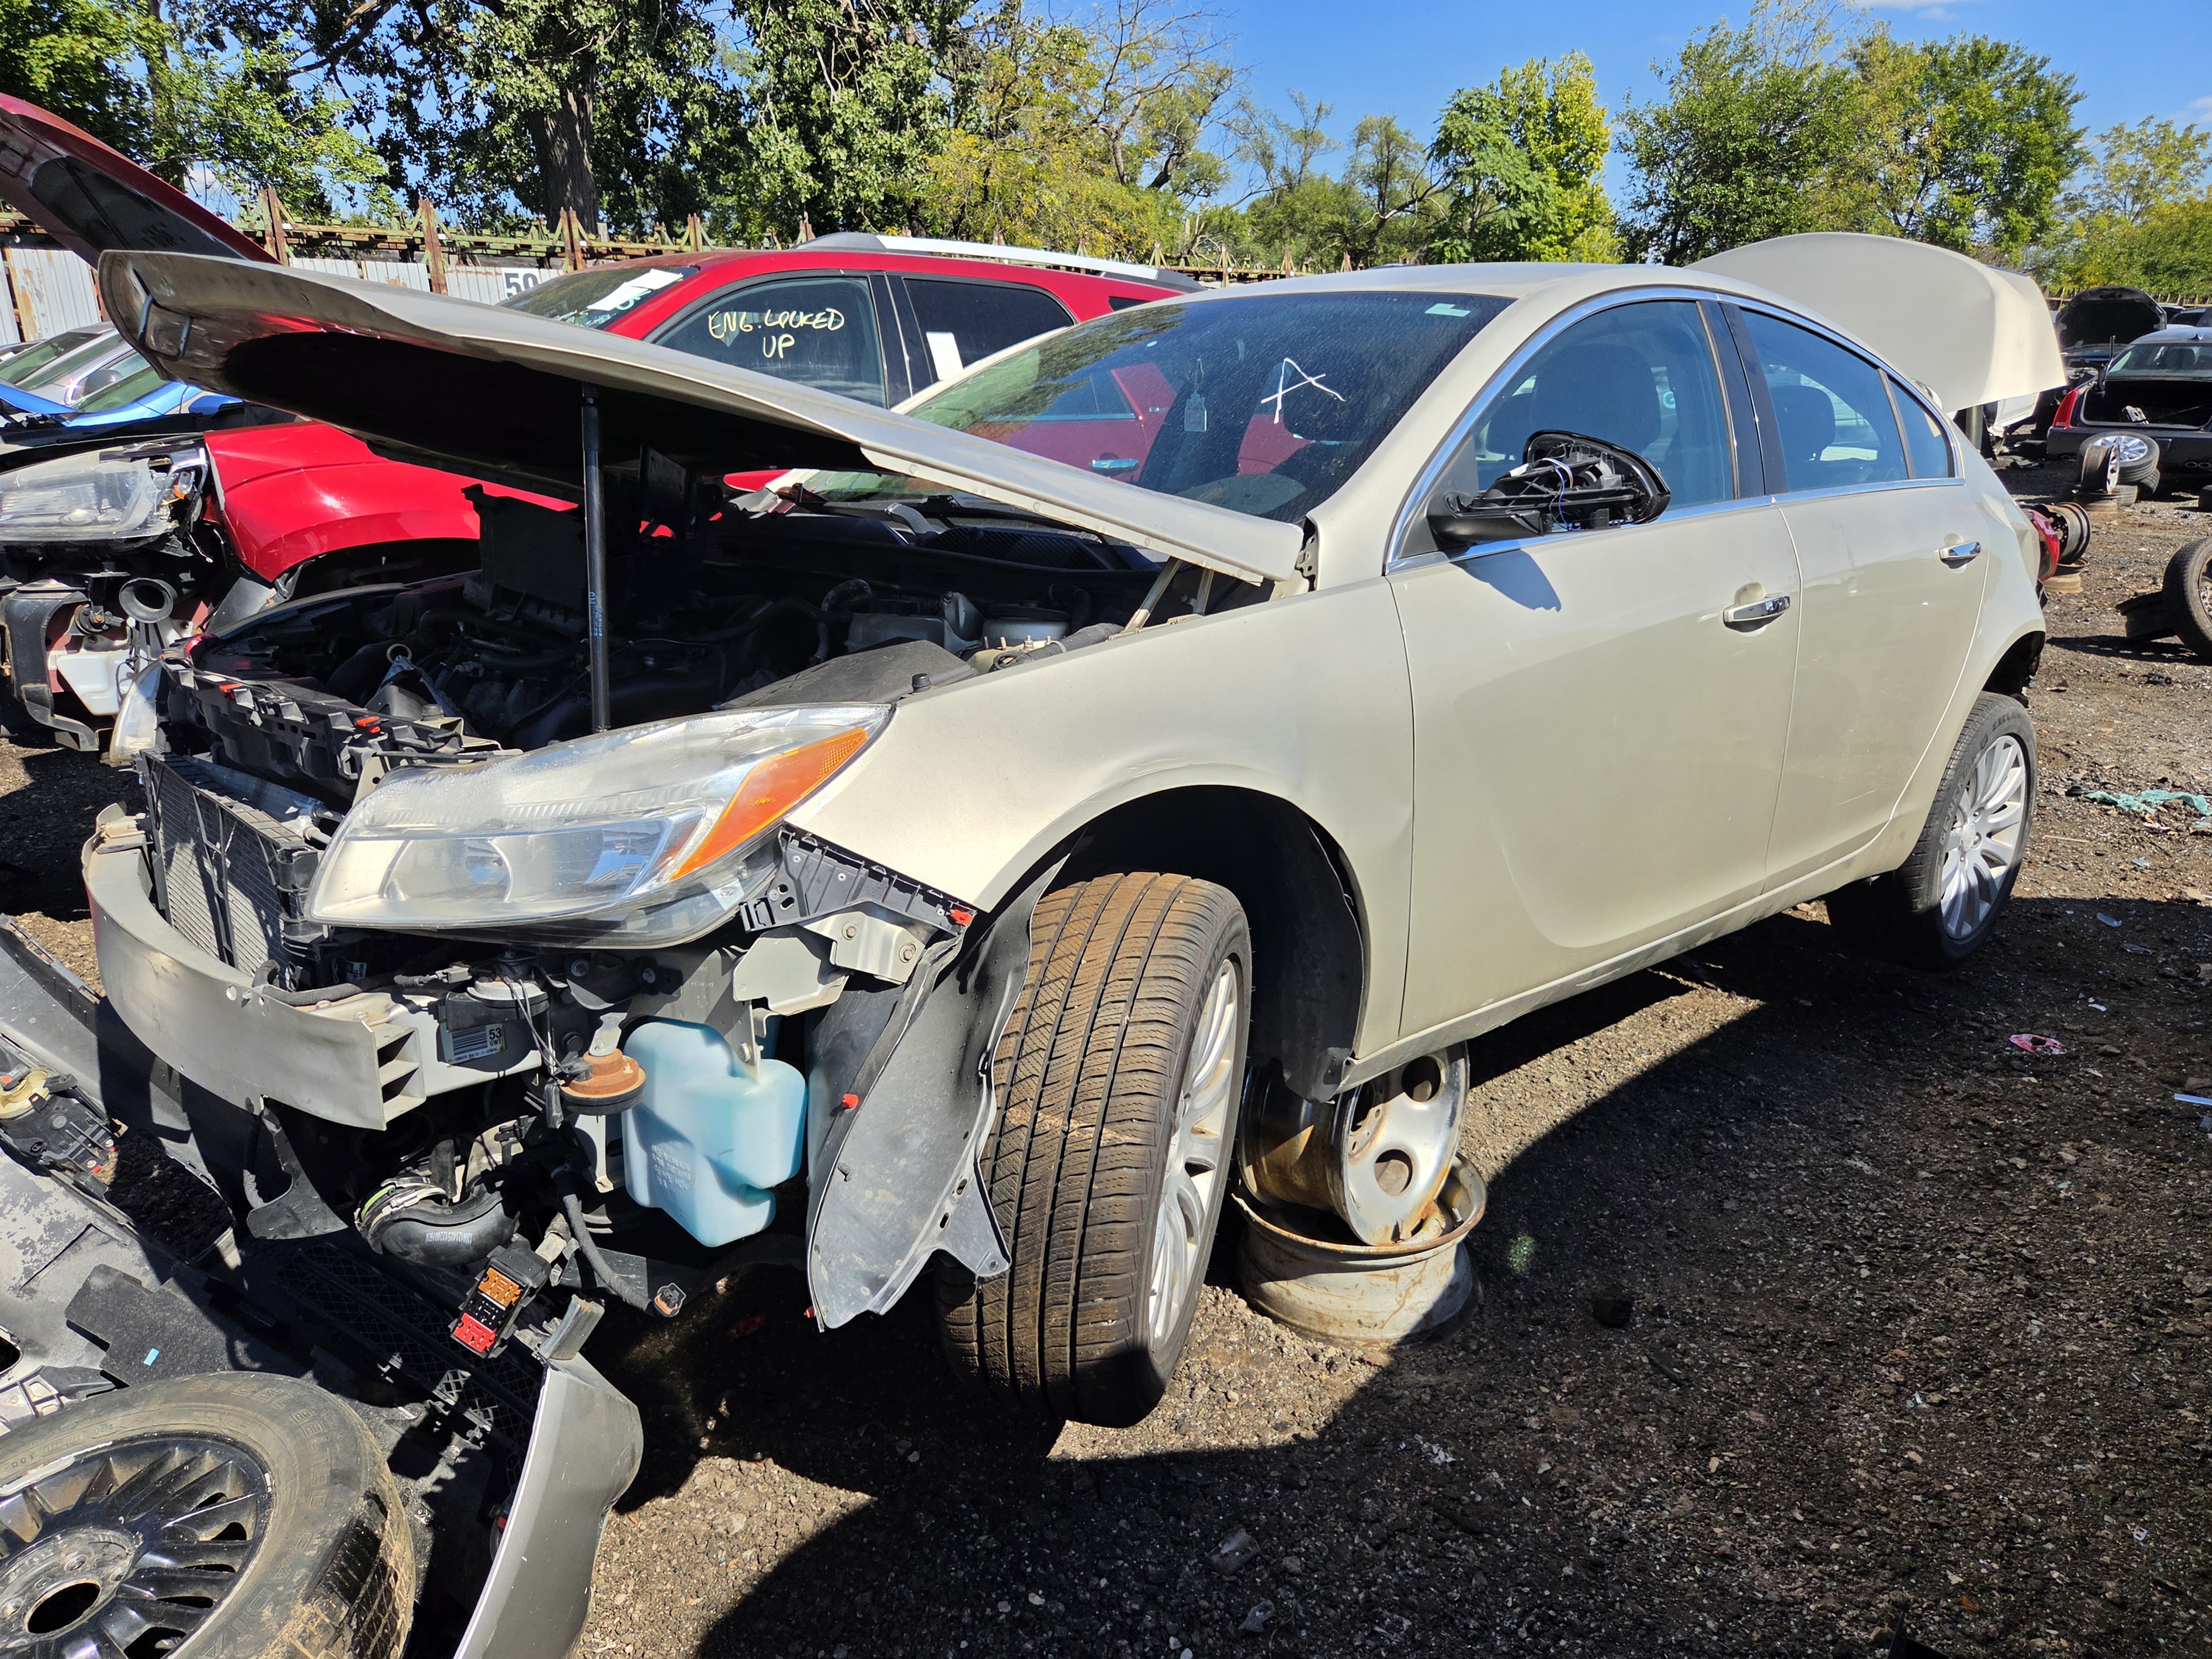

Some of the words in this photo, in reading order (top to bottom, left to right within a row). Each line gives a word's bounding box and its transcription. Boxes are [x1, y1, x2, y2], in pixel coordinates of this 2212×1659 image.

[763, 333, 795, 358] UP
[489, 1027, 502, 1040] 53
[187, 1382, 293, 1410] STEEL
[289, 1408, 332, 1511] BELTED
[11, 1452, 35, 1468] DOT
